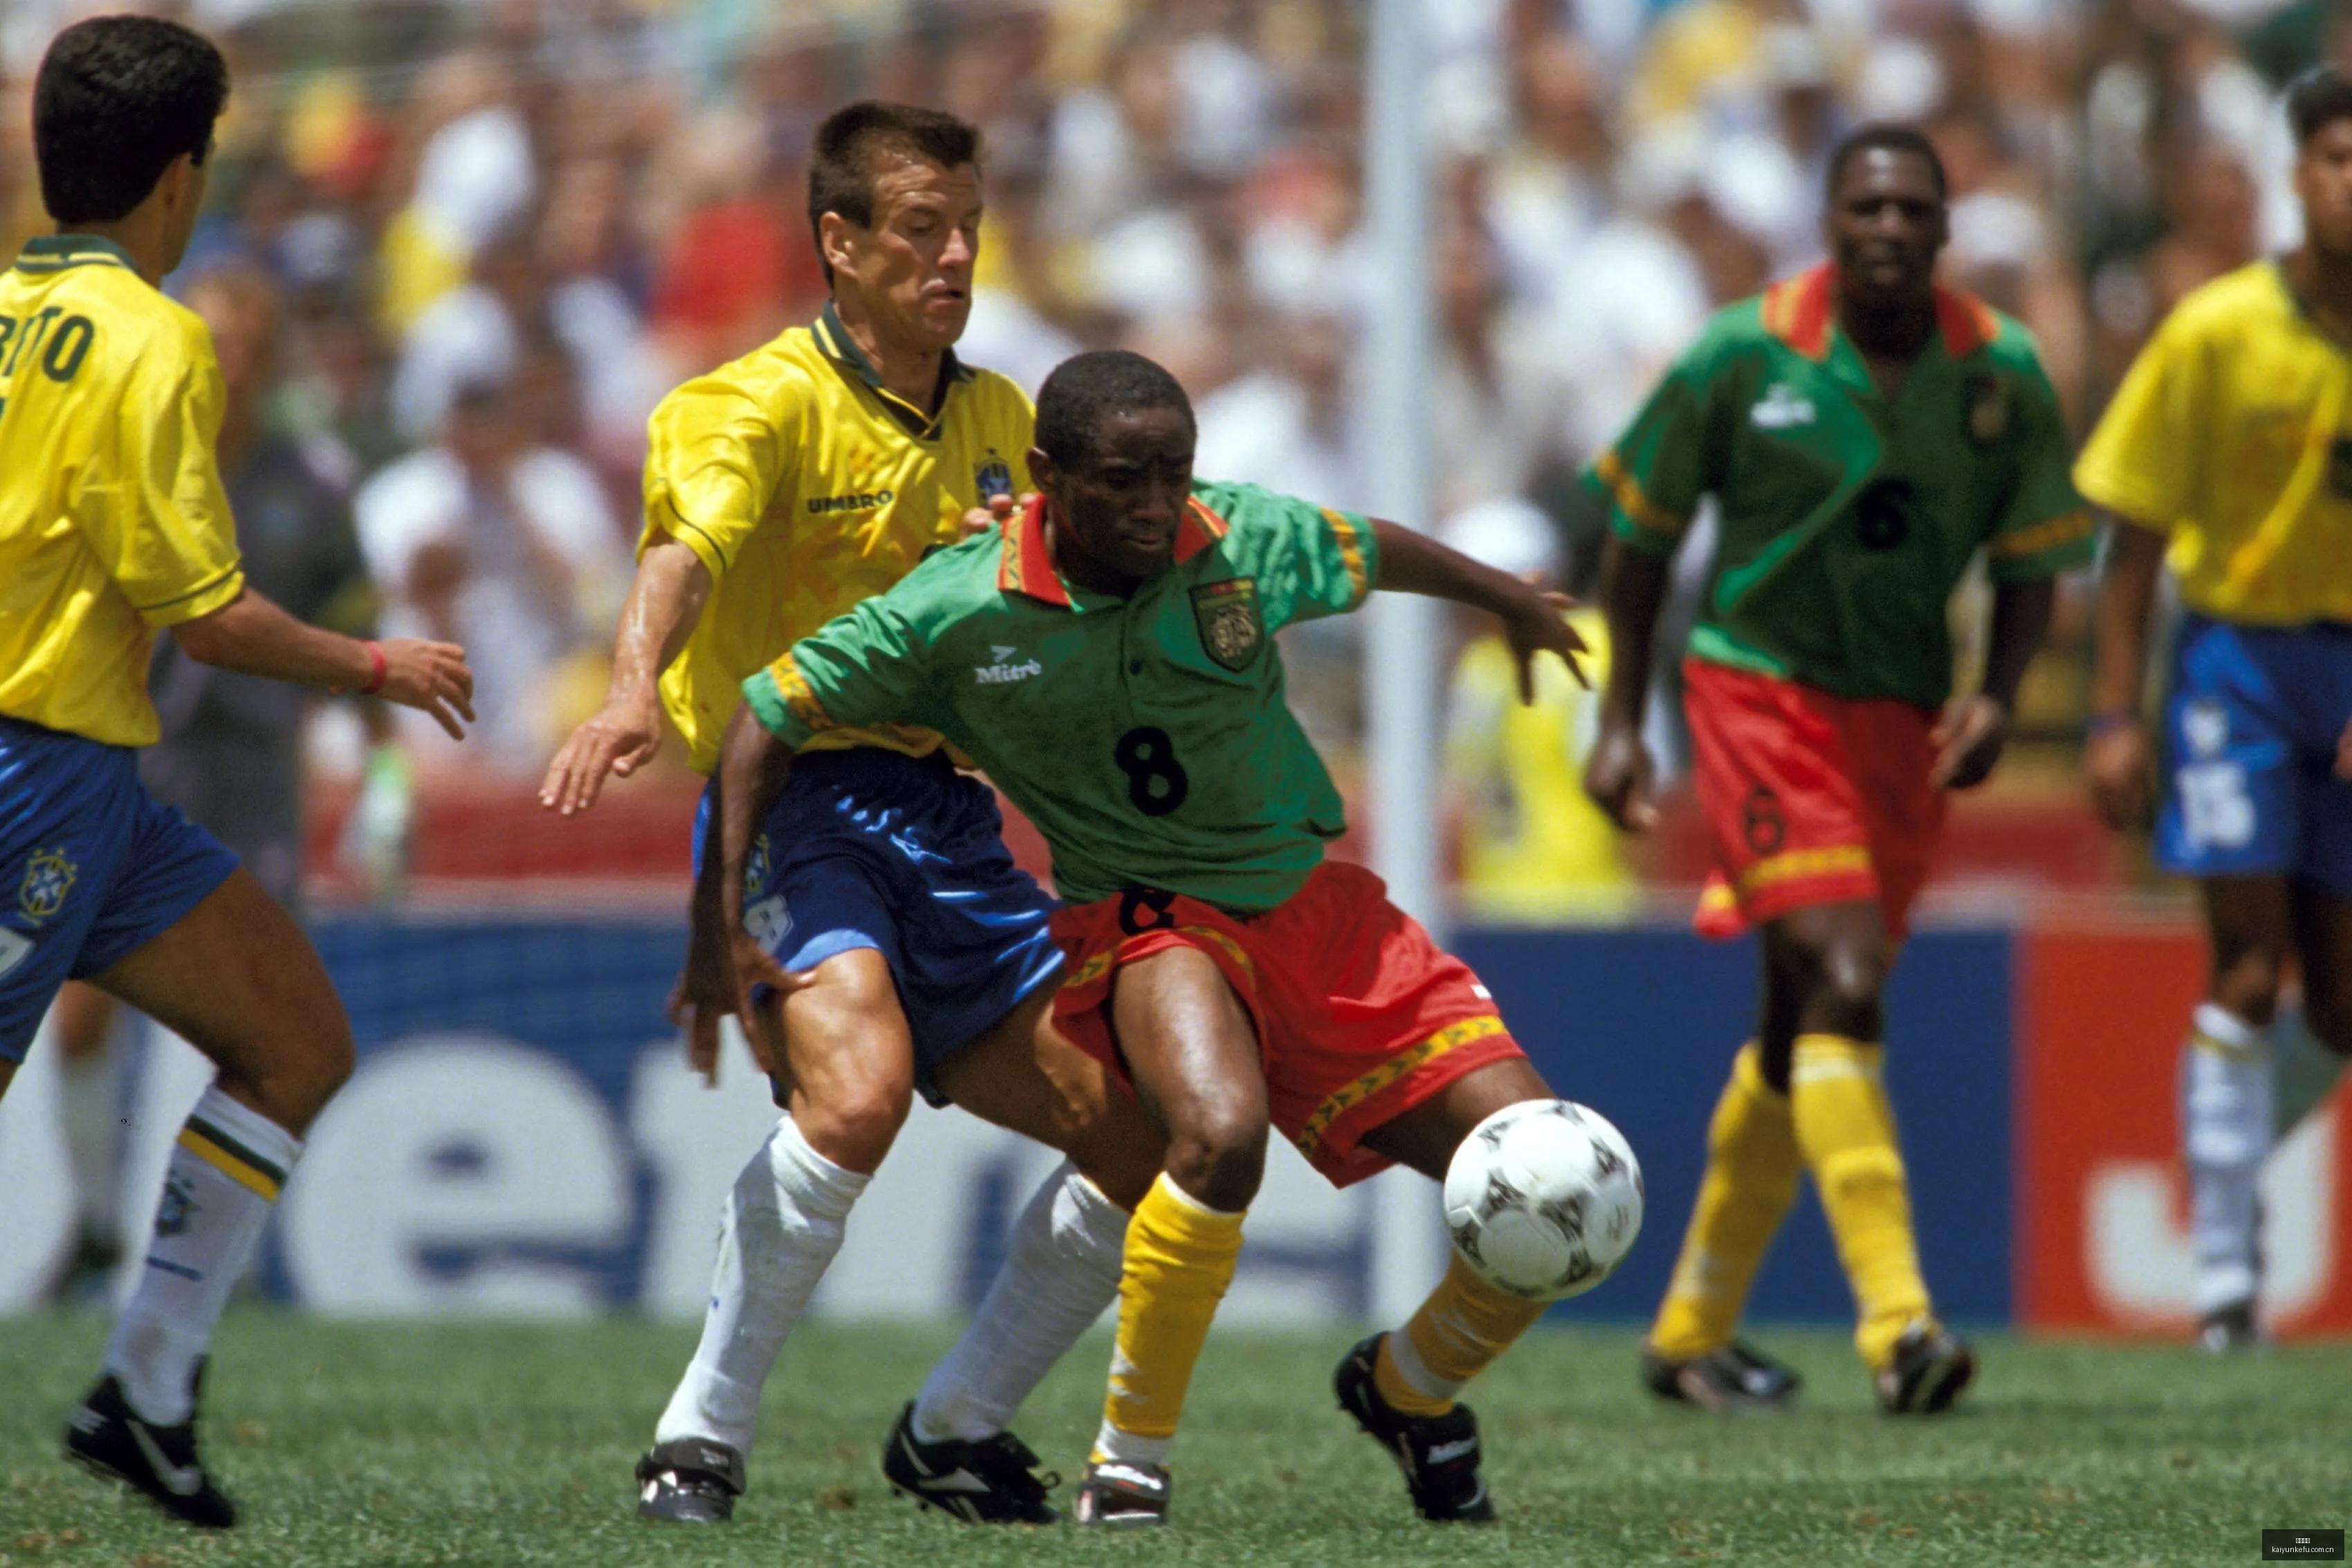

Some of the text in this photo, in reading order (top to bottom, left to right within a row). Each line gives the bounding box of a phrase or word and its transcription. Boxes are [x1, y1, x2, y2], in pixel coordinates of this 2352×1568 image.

[808, 489, 894, 514] UMBRO
[1857, 478, 1914, 550] 6
[1114, 726, 1188, 817] 8
